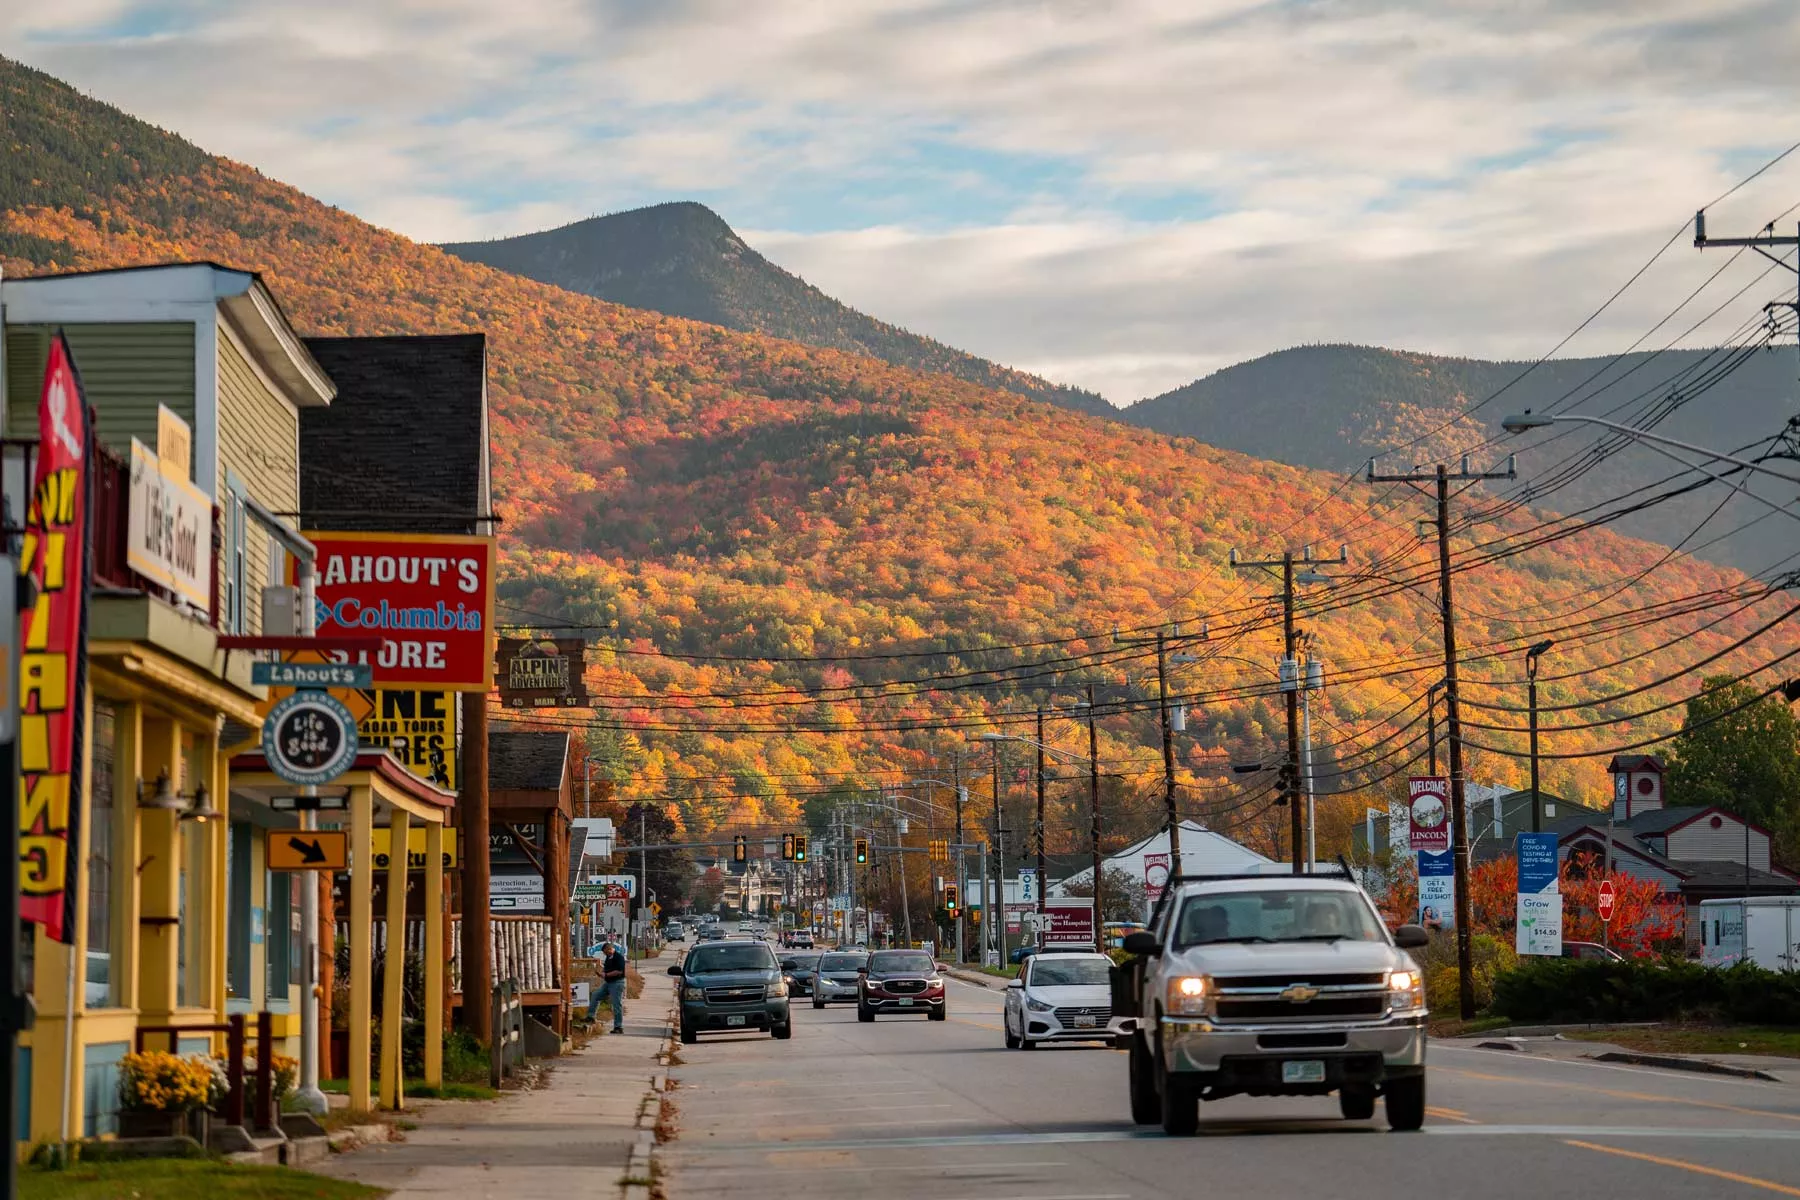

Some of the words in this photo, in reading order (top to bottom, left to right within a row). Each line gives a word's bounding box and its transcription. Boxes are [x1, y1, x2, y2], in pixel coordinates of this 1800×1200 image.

[146, 482, 162, 557] Life
[164, 496, 174, 567] is
[175, 505, 198, 579] Good
[333, 597, 481, 630] Columbia
[511, 659, 568, 674] ALPINE
[270, 665, 355, 683] Lahout's
[510, 675, 568, 688] ADVENTURES
[512, 698, 523, 706] 45
[534, 698, 555, 706] MAIN
[294, 713, 324, 732] Life
[404, 721, 444, 733] TOURS
[303, 729, 317, 742] is
[1409, 780, 1446, 796] WELCOME
[502, 836, 513, 845] 21
[1411, 832, 1447, 840] LINCOLN
[1144, 855, 1168, 867] WELCOME
[1523, 898, 1550, 907] Grow
[1600, 893, 1612, 907] STOP
[1534, 928, 1557, 936] $14.50
